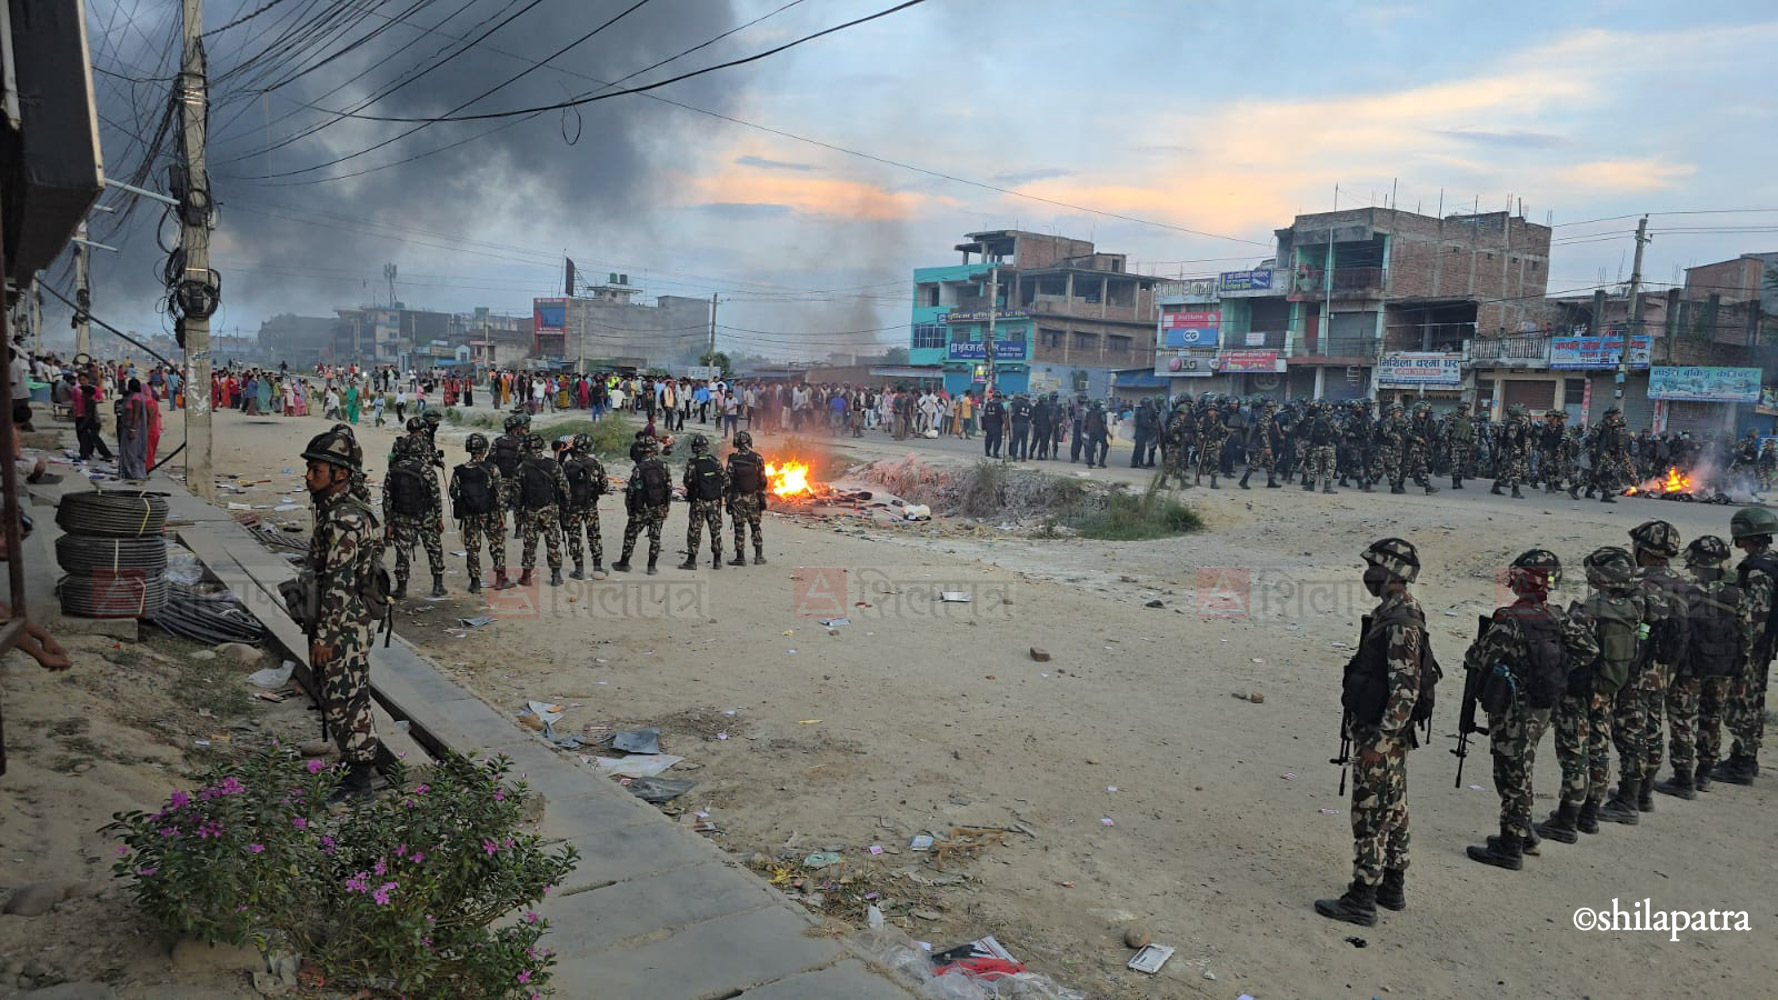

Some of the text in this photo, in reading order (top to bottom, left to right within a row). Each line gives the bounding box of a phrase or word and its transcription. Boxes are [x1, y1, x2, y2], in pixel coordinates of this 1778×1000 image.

[1182, 360, 1197, 368] LG
[1379, 356, 1412, 368] मिथिला
[1444, 359, 1459, 369] घर
